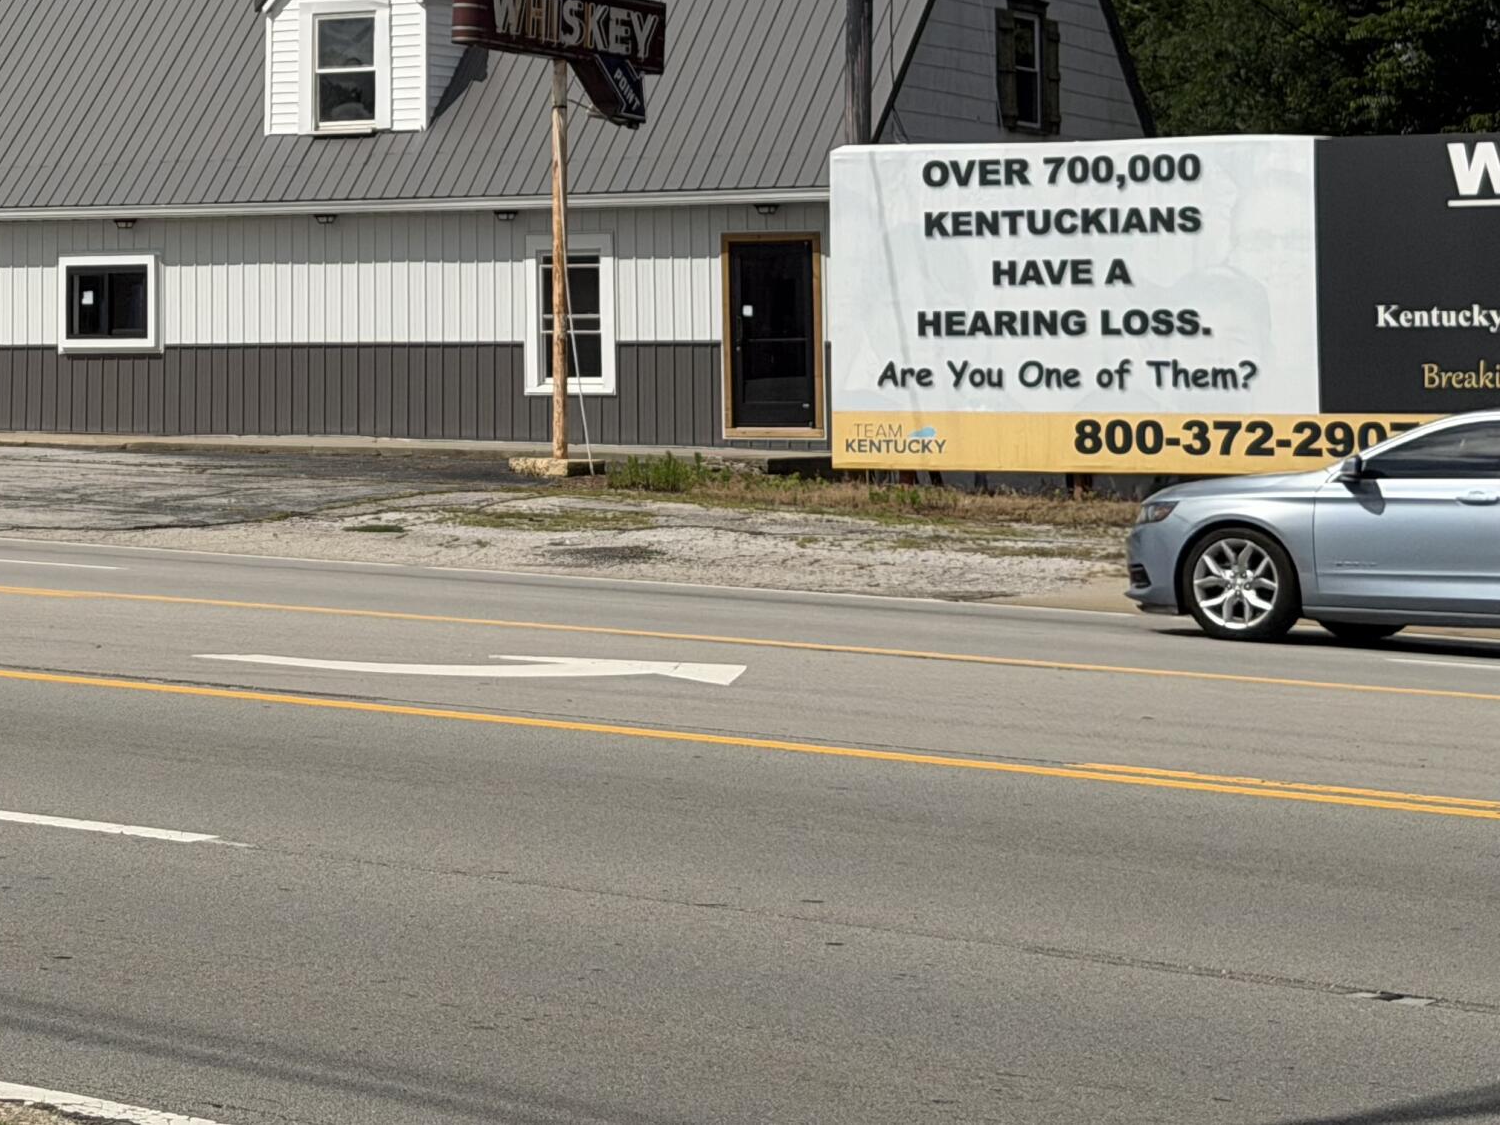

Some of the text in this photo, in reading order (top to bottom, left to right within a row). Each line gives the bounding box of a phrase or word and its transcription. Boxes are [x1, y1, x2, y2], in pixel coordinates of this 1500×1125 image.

[613, 67, 641, 111] POINT
[922, 153, 1201, 189] OVER 700,000
[924, 206, 1202, 237] KENTUCKIANS
[992, 258, 1133, 286] HAVE A
[917, 309, 1212, 337] HEARING LOSS.
[877, 359, 1257, 389] Are You One of Them?
[853, 423, 903, 439] TEAM
[845, 439, 947, 454] KENTUCKY
